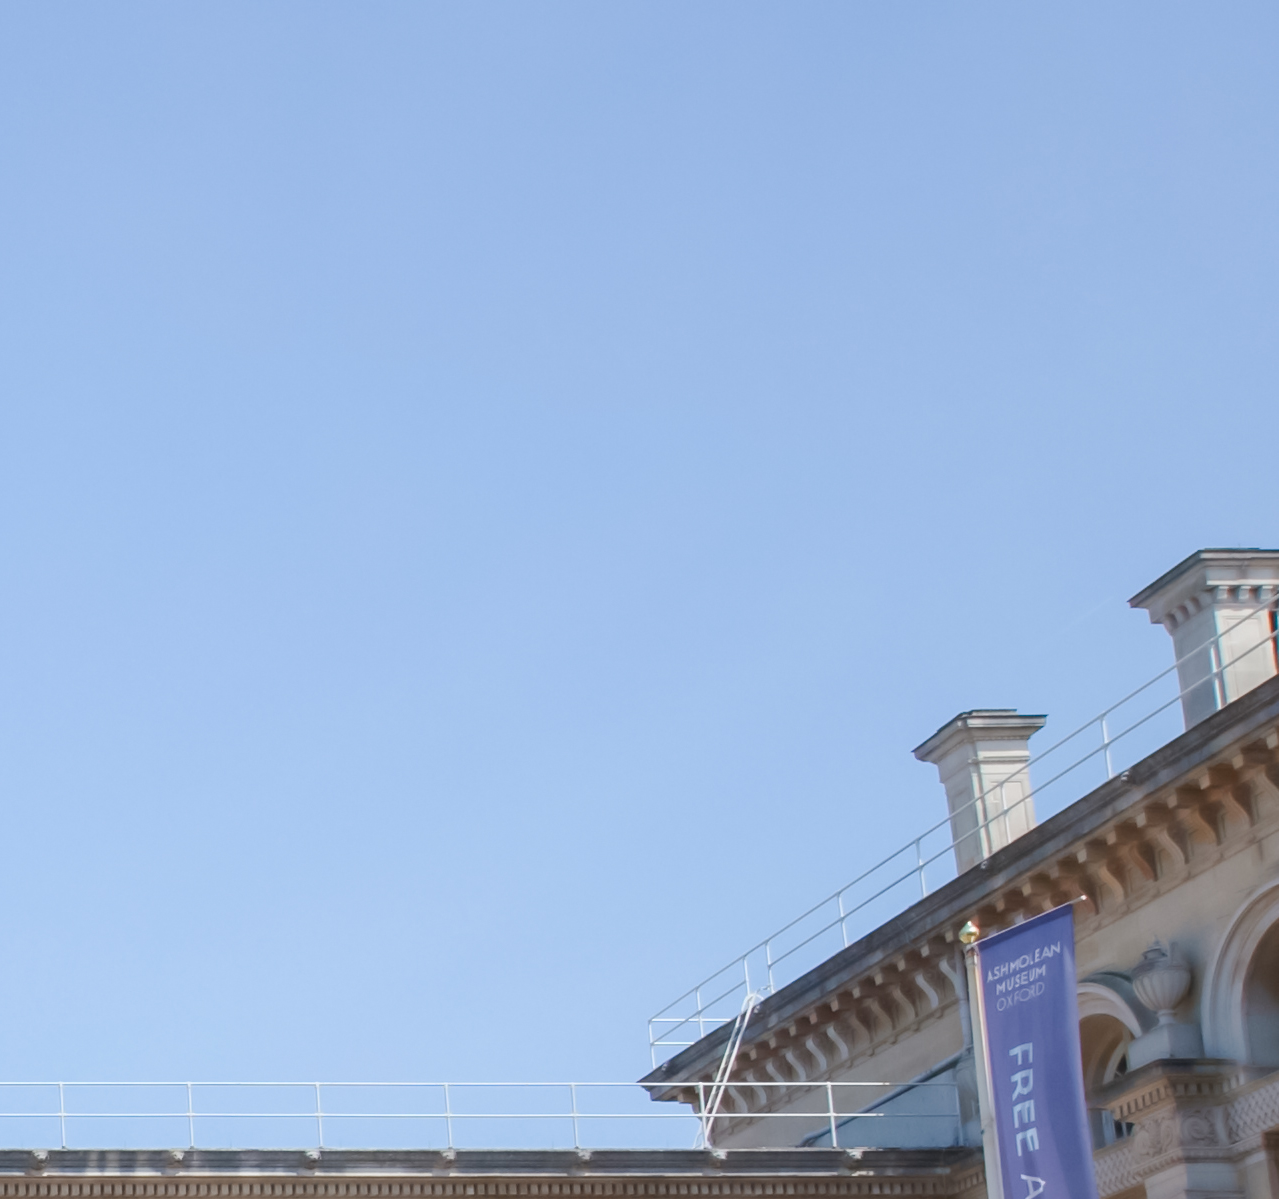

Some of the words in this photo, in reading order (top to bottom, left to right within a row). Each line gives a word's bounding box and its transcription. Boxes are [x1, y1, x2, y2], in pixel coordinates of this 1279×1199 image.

[987, 941, 1061, 983] ASHMOLEAN
[996, 964, 1046, 996] MUSEUM
[996, 981, 1045, 1011] OXFORD
[1009, 1042, 1039, 1157] FREE
